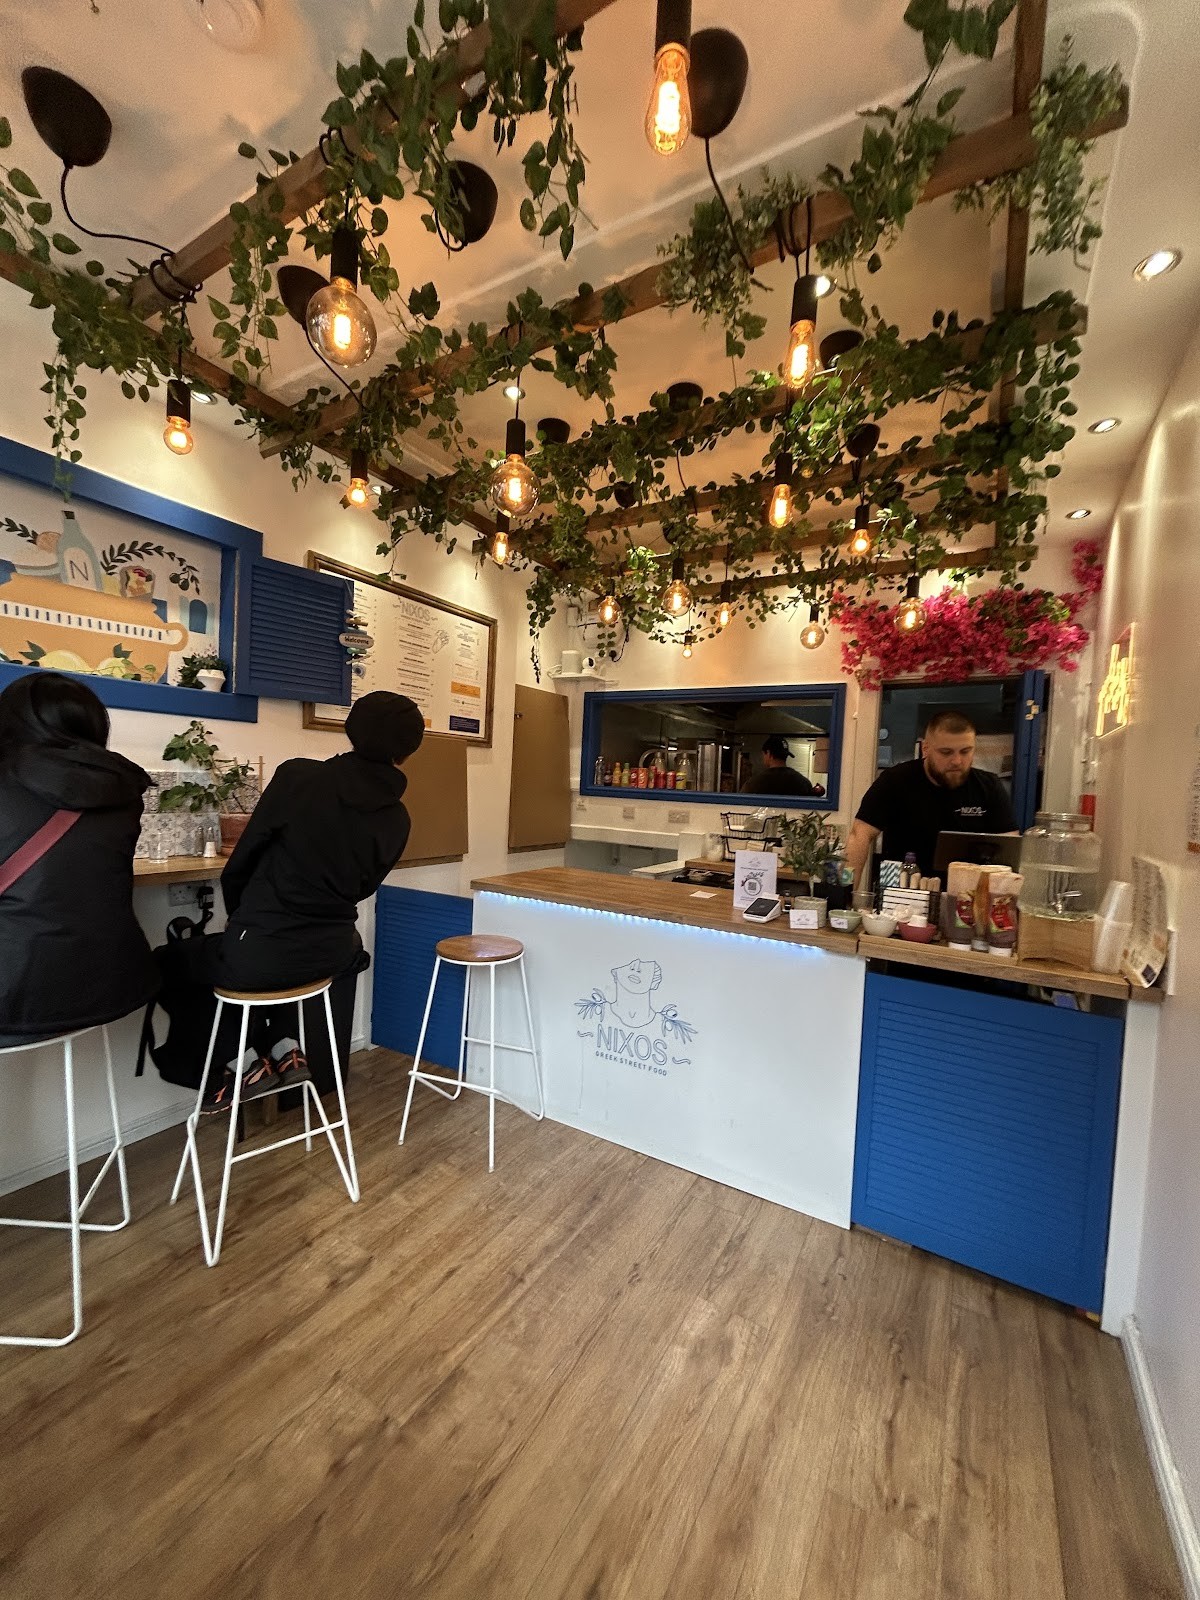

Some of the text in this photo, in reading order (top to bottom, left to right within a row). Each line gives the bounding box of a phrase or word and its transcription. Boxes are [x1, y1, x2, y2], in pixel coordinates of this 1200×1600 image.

[70, 560, 89, 581] N
[401, 602, 431, 622] NIXOS
[344, 636, 369, 645] Welcome
[597, 1024, 667, 1065] NIXOS
[595, 1050, 667, 1076] GREEK STREET FOOD
